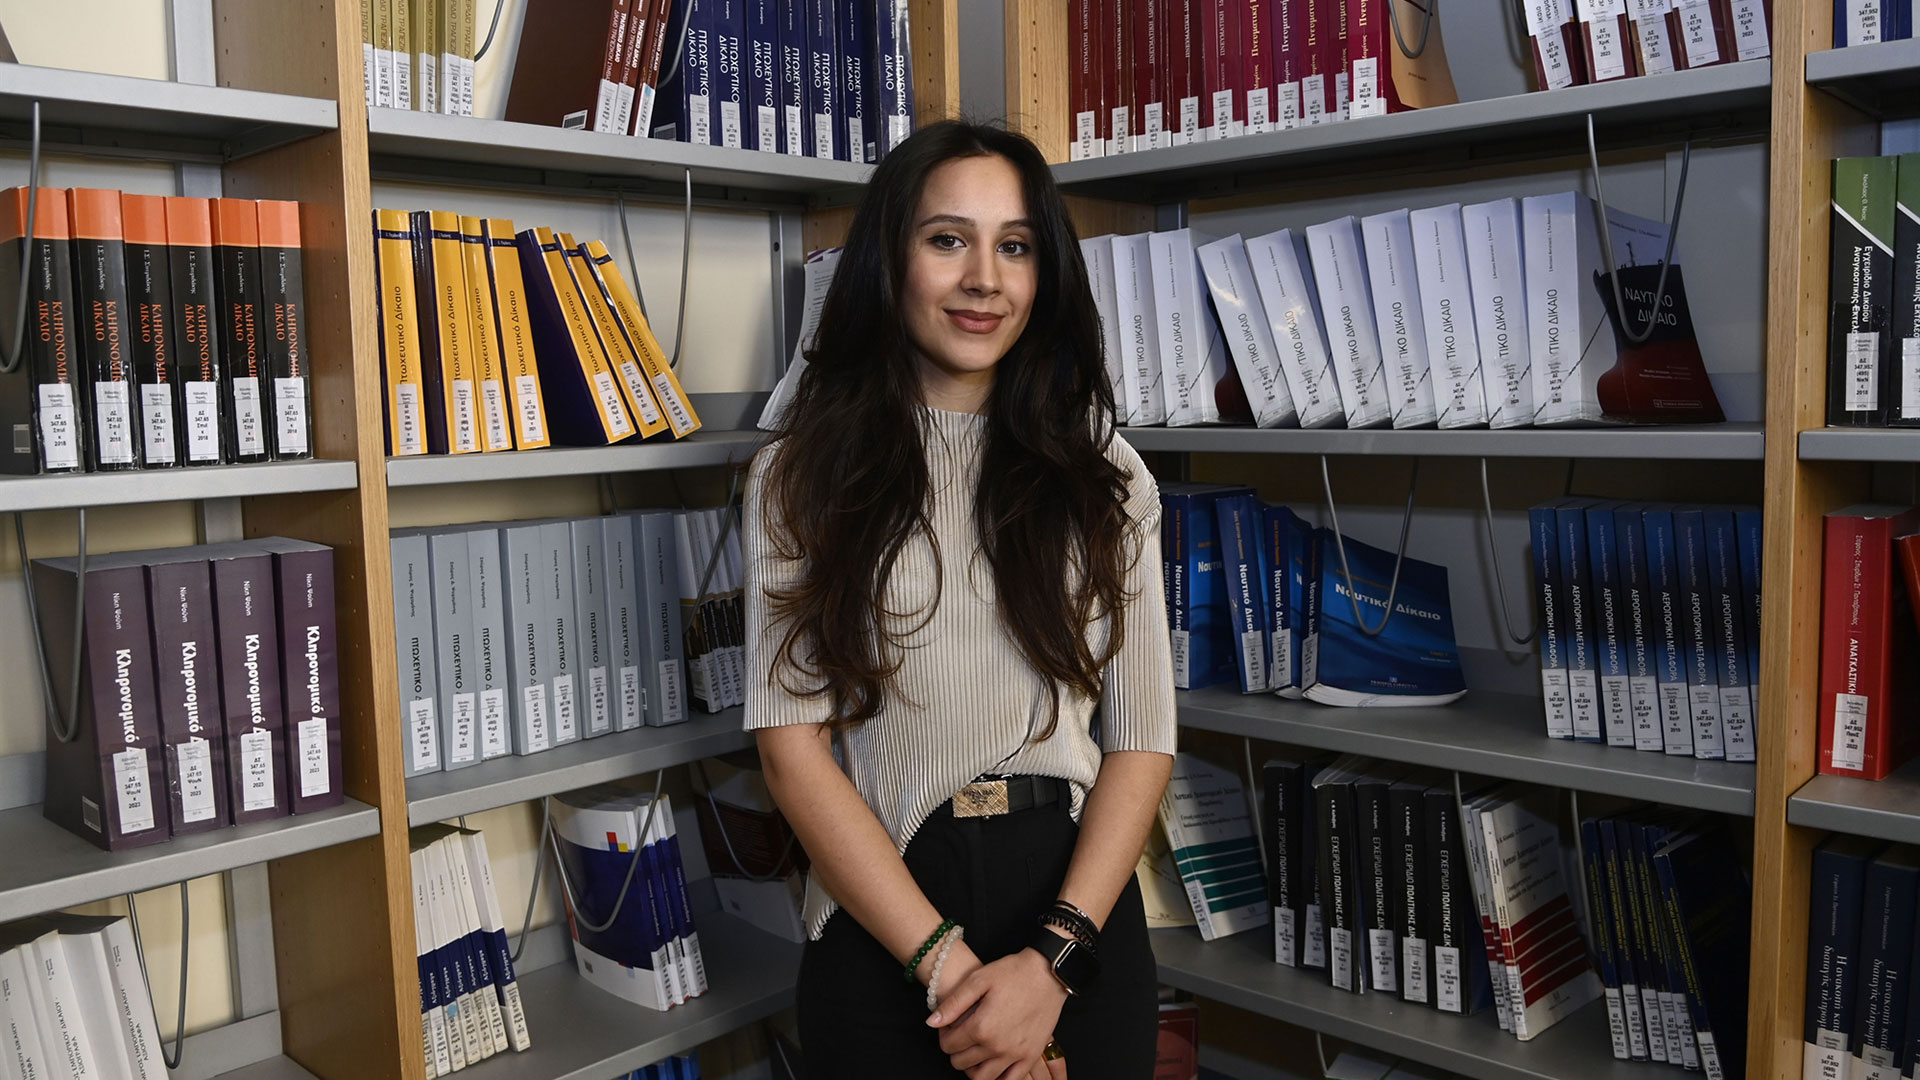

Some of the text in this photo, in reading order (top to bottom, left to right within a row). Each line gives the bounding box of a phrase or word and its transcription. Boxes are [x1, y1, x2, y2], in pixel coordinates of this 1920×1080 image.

[688, 28, 697, 68] ΔΙΚΑΙΟ
[698, 30, 709, 97] ΠΤΩΧΕΥΤΙΚΟ
[718, 35, 728, 74] ΔΙΚΑΙΟ
[730, 36, 740, 104] ΠΤΩΧΕΥΤΙΚΟ
[754, 40, 762, 78] ΔΙΚΑΙΟ
[763, 42, 774, 108] ΠΤΩΧΕΥΤΙΚΟ
[813, 52, 822, 88] ΔΙΚΑΙΟ
[884, 54, 894, 90] ΔΙΚΑΙΟ
[792, 48, 802, 109] ΠΤΩΧΕΥΤΙΚΟ
[822, 53, 832, 116] ΠΤΩΧΕΥΤΙΚΟ
[854, 58, 862, 120] ΠΤΩΧΕΥΤΙΚΟ
[896, 55, 906, 118] ΠΤΩΧΕΥΤΙΚΟ
[38, 300, 50, 342] ΔΙΚΑΙΟ
[94, 300, 105, 341] ΔΙΚΑΙΟ
[140, 304, 150, 342] ΔΙΚΑΙΟ
[185, 304, 196, 343] ΔΙΚΑΙΟ
[234, 304, 244, 342] ΔΙΚΑΙΟ
[274, 303, 285, 340] ΔΙΚΑΙΟ
[394, 286, 404, 320] Δίκαιο
[446, 285, 456, 320] Δίκαιο
[475, 288, 484, 322] Δίκαιο
[565, 292, 581, 322] Δίκαιο
[618, 300, 636, 328] Δίκαιο
[1547, 289, 1559, 355] ΤΙΚΟ ΔΙΚΑΙΟ
[1624, 287, 1673, 307] ΝΑΥΤΙΟ
[52, 302, 68, 384] ΚΛΗΡΟΝΟΜΙ
[106, 301, 122, 382] ΚΛΗΡΟΝΟΜΙΚ
[152, 304, 168, 384] ΚΛΗΡΟΝΟΜΙΚ
[197, 304, 210, 382] ΚΛΗΡΟΝΟΜΙΚ
[245, 304, 256, 378] ΚΛΗΡΟΝΟΜΙ
[286, 304, 300, 378] ΚΛΗΡΟΝΟΜΙΚ
[510, 290, 527, 376] τωχευτικό Δίκαιο
[1134, 314, 1144, 344] ΔΙΚΑΙΟ
[1172, 312, 1184, 367] ΤΙΚΟ ΔΙΚΑΙΟ
[1238, 313, 1260, 364] ΤΙΚΟ ΔΙΚΑΙΟ
[1285, 310, 1307, 364] ΤΙΚΟ ΔΙΚΑΙΟ
[1341, 306, 1360, 362] ΤΙΚΟ ΔΙΚΑΙΟ
[1392, 302, 1408, 360] ΤΙΚΟ ΔΙΚΑΙΟ
[1440, 299, 1456, 360] ΤΙΚΟ ΔΙΚΑΙΟ
[1493, 296, 1509, 358] ΤΙΚΟ ΔΙΚΑΙΟ
[661, 602, 670, 652] ΠΤΩΧΕΥΤΙΚΟ
[1240, 564, 1254, 637] Ναυτικό Δίκαι
[1396, 603, 1440, 620] Δίκαιο
[1544, 584, 1555, 630] ΑΕΡΟΠΟΡΙΚΗ
[1573, 584, 1586, 670] ΑΕΡΟΠΟΡΙΚΗ ΜΕΤΑΦΟΡΑ
[1604, 588, 1614, 637] ΑΕΡΟΠΟΡΙΚΗ
[483, 628, 492, 681] ΠΤΩΧΕΥΤΙΚΟ
[528, 623, 536, 676] ΠΤΩΧΕΥΤΙΚΟ
[557, 618, 566, 670] ΠΤΩΧΕΥΤΙΚΟ
[590, 612, 598, 662] ΠΤΩΧΕΥΤΙΚΟ
[622, 608, 630, 657] ΠΤΩΧΕΥΤΙΚΟ
[1546, 630, 1558, 668] ΜΕΤΑΦΟΡΑ
[1608, 636, 1618, 675] ΜΕΤΑΦΟΡΑ
[1632, 590, 1646, 677] ΑΕΡΟΠΟΡΙΚΗ ΜΕΤΑΦΟΡΑ
[1662, 592, 1678, 681] ΑΕΡΟΠΟΡΙΚΗ ΜΕΤΑΦΟΡΑ
[1692, 593, 1706, 682] ΑΕΡΟΠΟΡΙΚΗ ΜΕΤΑΦΟΡΑ
[1722, 594, 1736, 685] ΑΕΡΟΠΟΡΙΚΗ ΜΕΤΑΦΟΡΑ
[181, 642, 204, 732] Κληρονομικό
[244, 634, 266, 724] Κληρονομικό
[304, 626, 324, 714] Κληρονομικό
[412, 637, 422, 692] ΠΤΩΧΕΥΤΙΚΟ
[453, 634, 462, 689] ΠΤΩΧΕΥΤΙΚΟ
[1848, 638, 1858, 694] ΑΝΑΓΚΑΣΤΙΚΗ
[116, 649, 140, 743] Κληρονομικό
[1332, 836, 1342, 914] ΕΓΧΕΙΡΙΔΙΟ ΠΟΛΙΤΙΚΗΣ
[1373, 837, 1384, 914] ΕΓΧΕΙΡΙΔΙΟ ΠΟΛΙΤΙΚΗΣ
[1441, 850, 1451, 931] ΕΓΧΕΙΡΙΔΙΟ ΠΟΛΙΤΙΚΗΣ
[1838, 956, 1848, 965] Η
[1887, 970, 1897, 980] Η
[1818, 988, 1828, 1028] πληρωμ
[1864, 1002, 1878, 1046] πληρωμ
